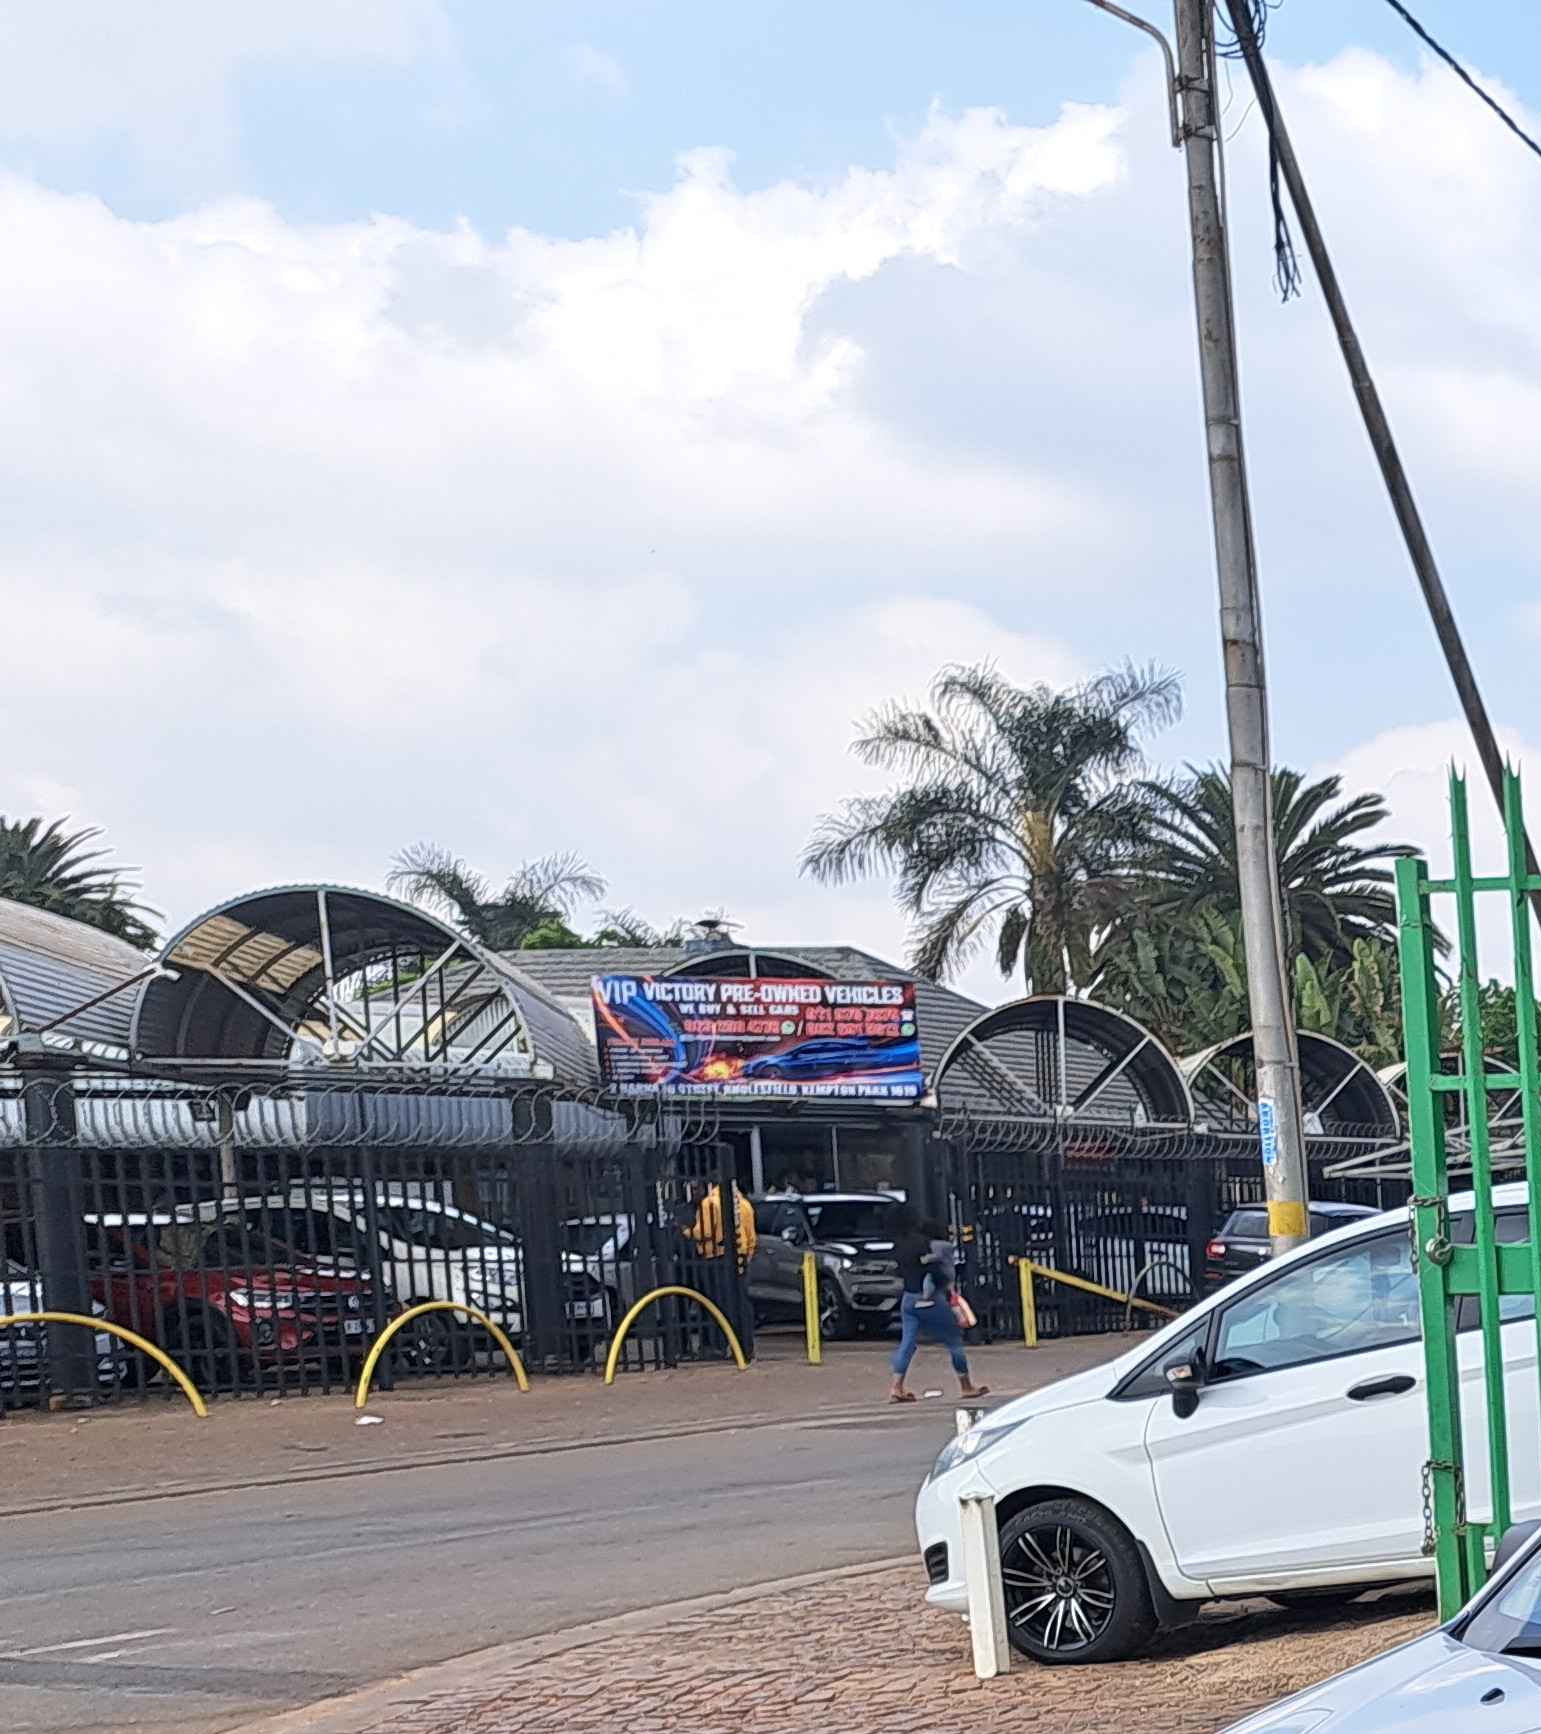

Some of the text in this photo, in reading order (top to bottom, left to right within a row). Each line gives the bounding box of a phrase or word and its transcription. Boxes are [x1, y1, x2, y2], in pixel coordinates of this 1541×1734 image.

[600, 980, 904, 1006] VIP VICTORY PRE-OWNED VEHICLES
